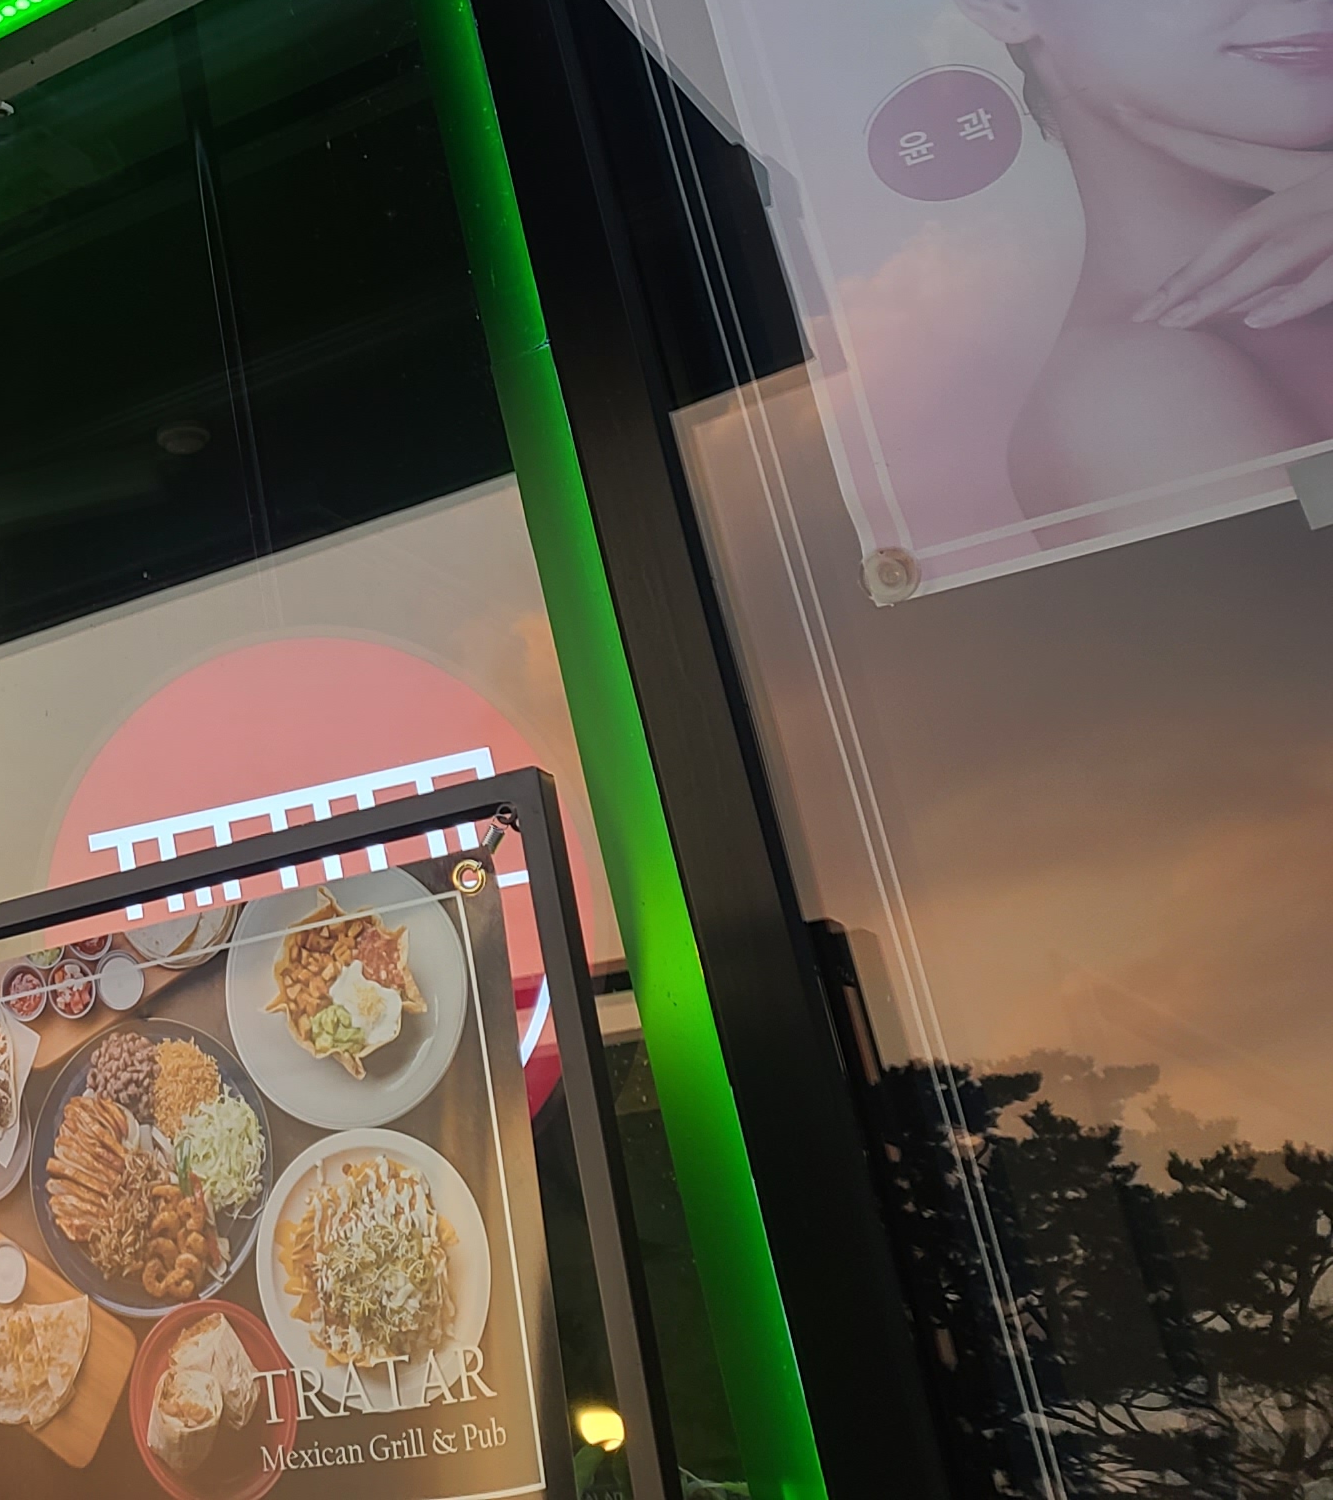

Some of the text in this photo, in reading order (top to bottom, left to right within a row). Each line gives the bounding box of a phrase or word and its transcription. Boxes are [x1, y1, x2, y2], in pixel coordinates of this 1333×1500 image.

[252, 1344, 498, 1425] TRATAR
[260, 1416, 508, 1474] Mexican Grill & Pub
